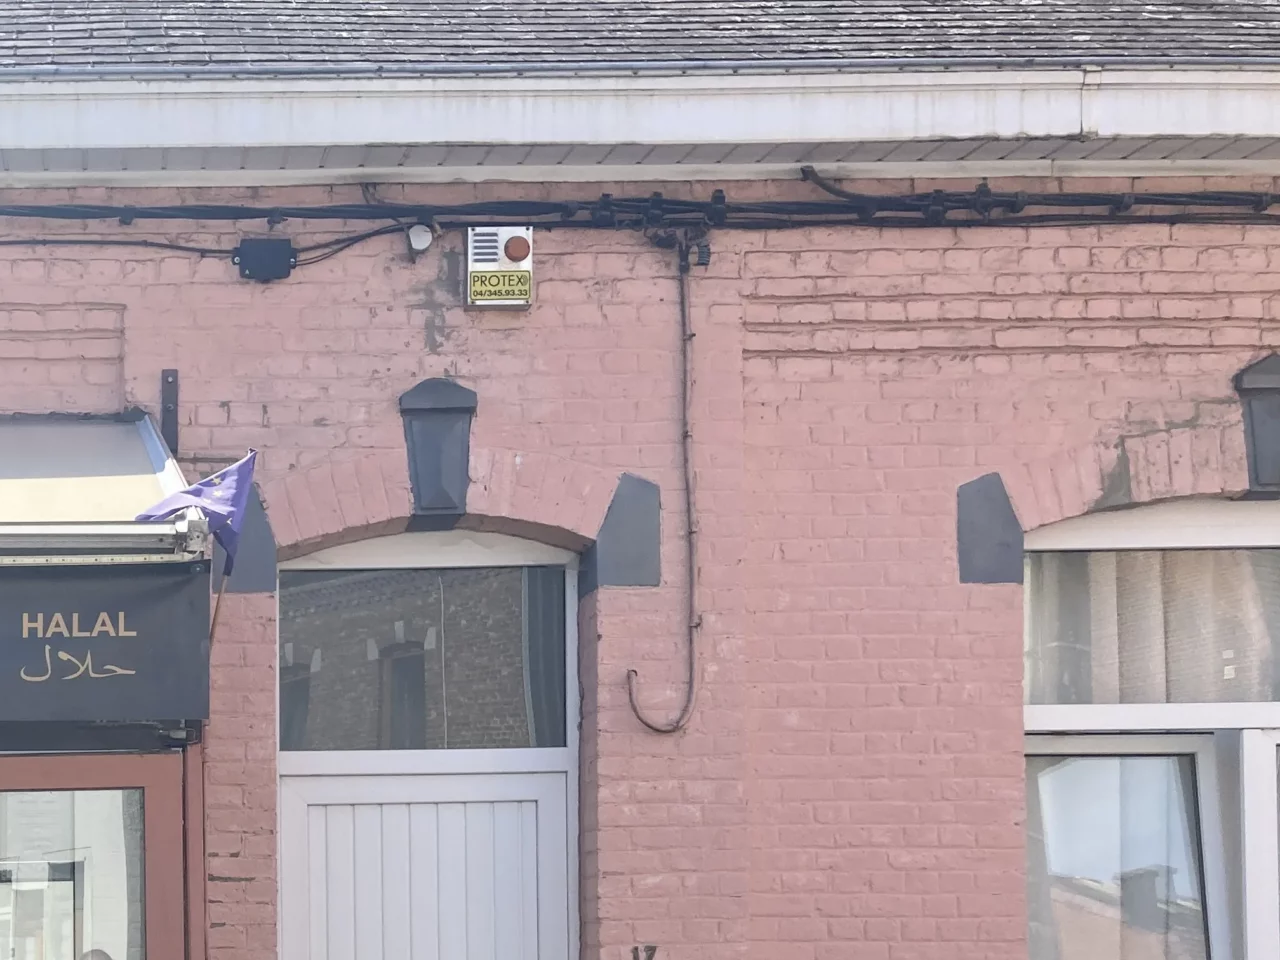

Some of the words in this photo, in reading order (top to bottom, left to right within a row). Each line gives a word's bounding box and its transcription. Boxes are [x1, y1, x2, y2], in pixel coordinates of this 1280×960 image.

[472, 274, 524, 287] PROTEX
[472, 289, 528, 297] 04/345.93.33
[22, 611, 138, 639] HALAL
[20, 644, 137, 682] حلال
